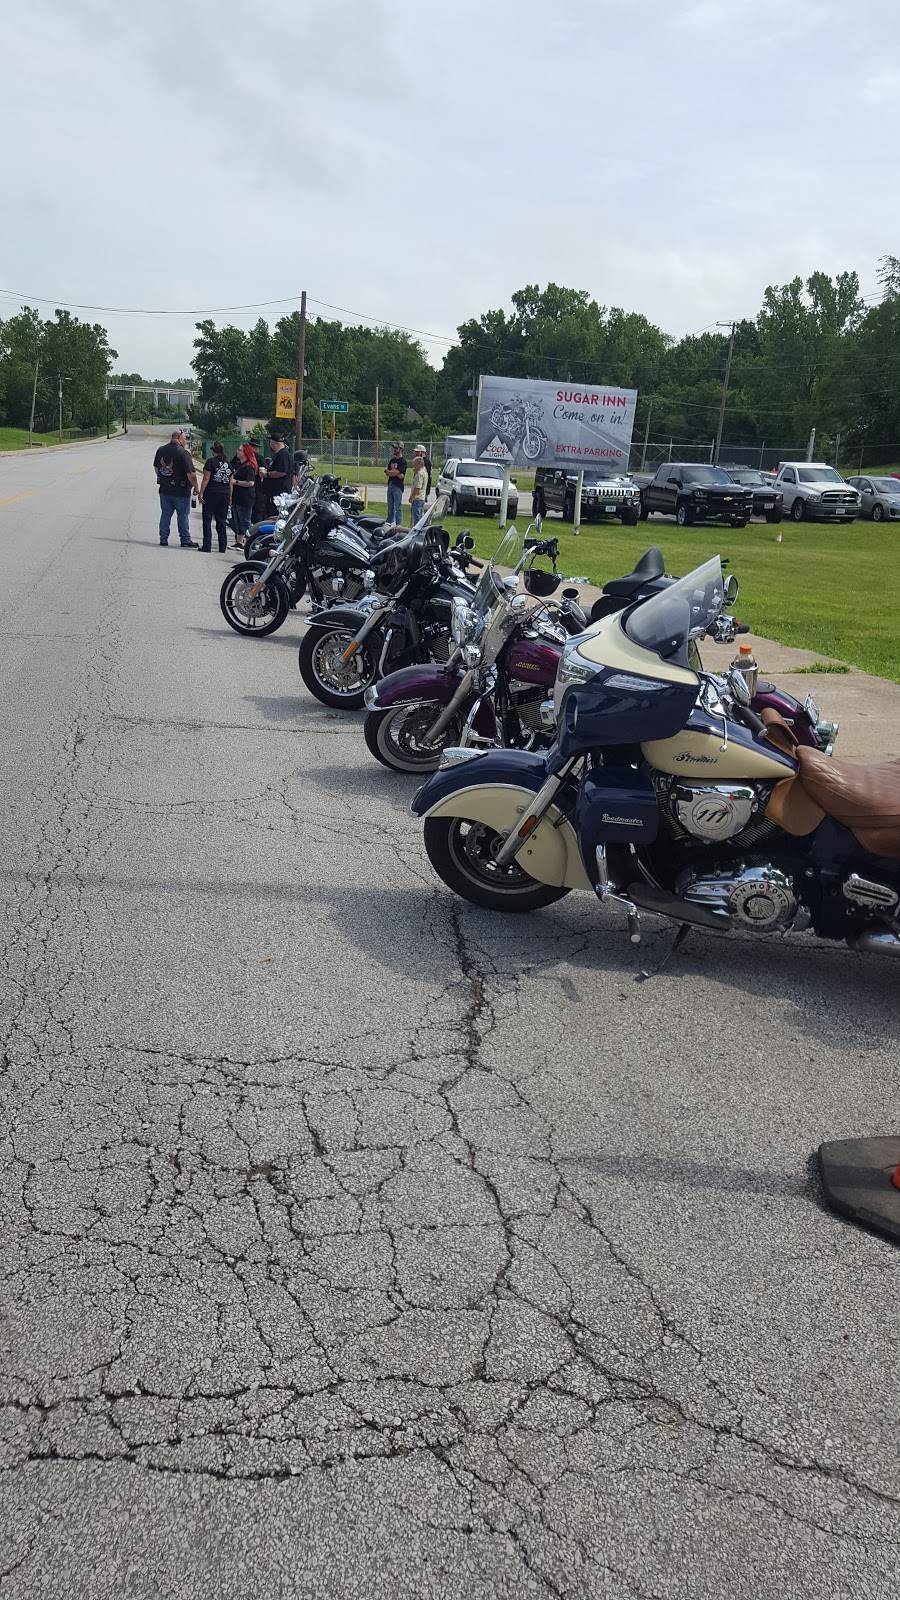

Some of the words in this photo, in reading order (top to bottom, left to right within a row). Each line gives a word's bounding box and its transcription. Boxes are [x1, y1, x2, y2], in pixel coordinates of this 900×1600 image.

[556, 391, 599, 405] SUGAR
[602, 395, 626, 407] INN
[553, 405, 584, 421] Come
[590, 413, 605, 423] on
[610, 409, 628, 424] in!
[485, 443, 509, 453] Coors
[556, 444, 582, 454] EXTRA
[584, 447, 622, 457] PARKING
[602, 813, 643, 824] Roadmaster
